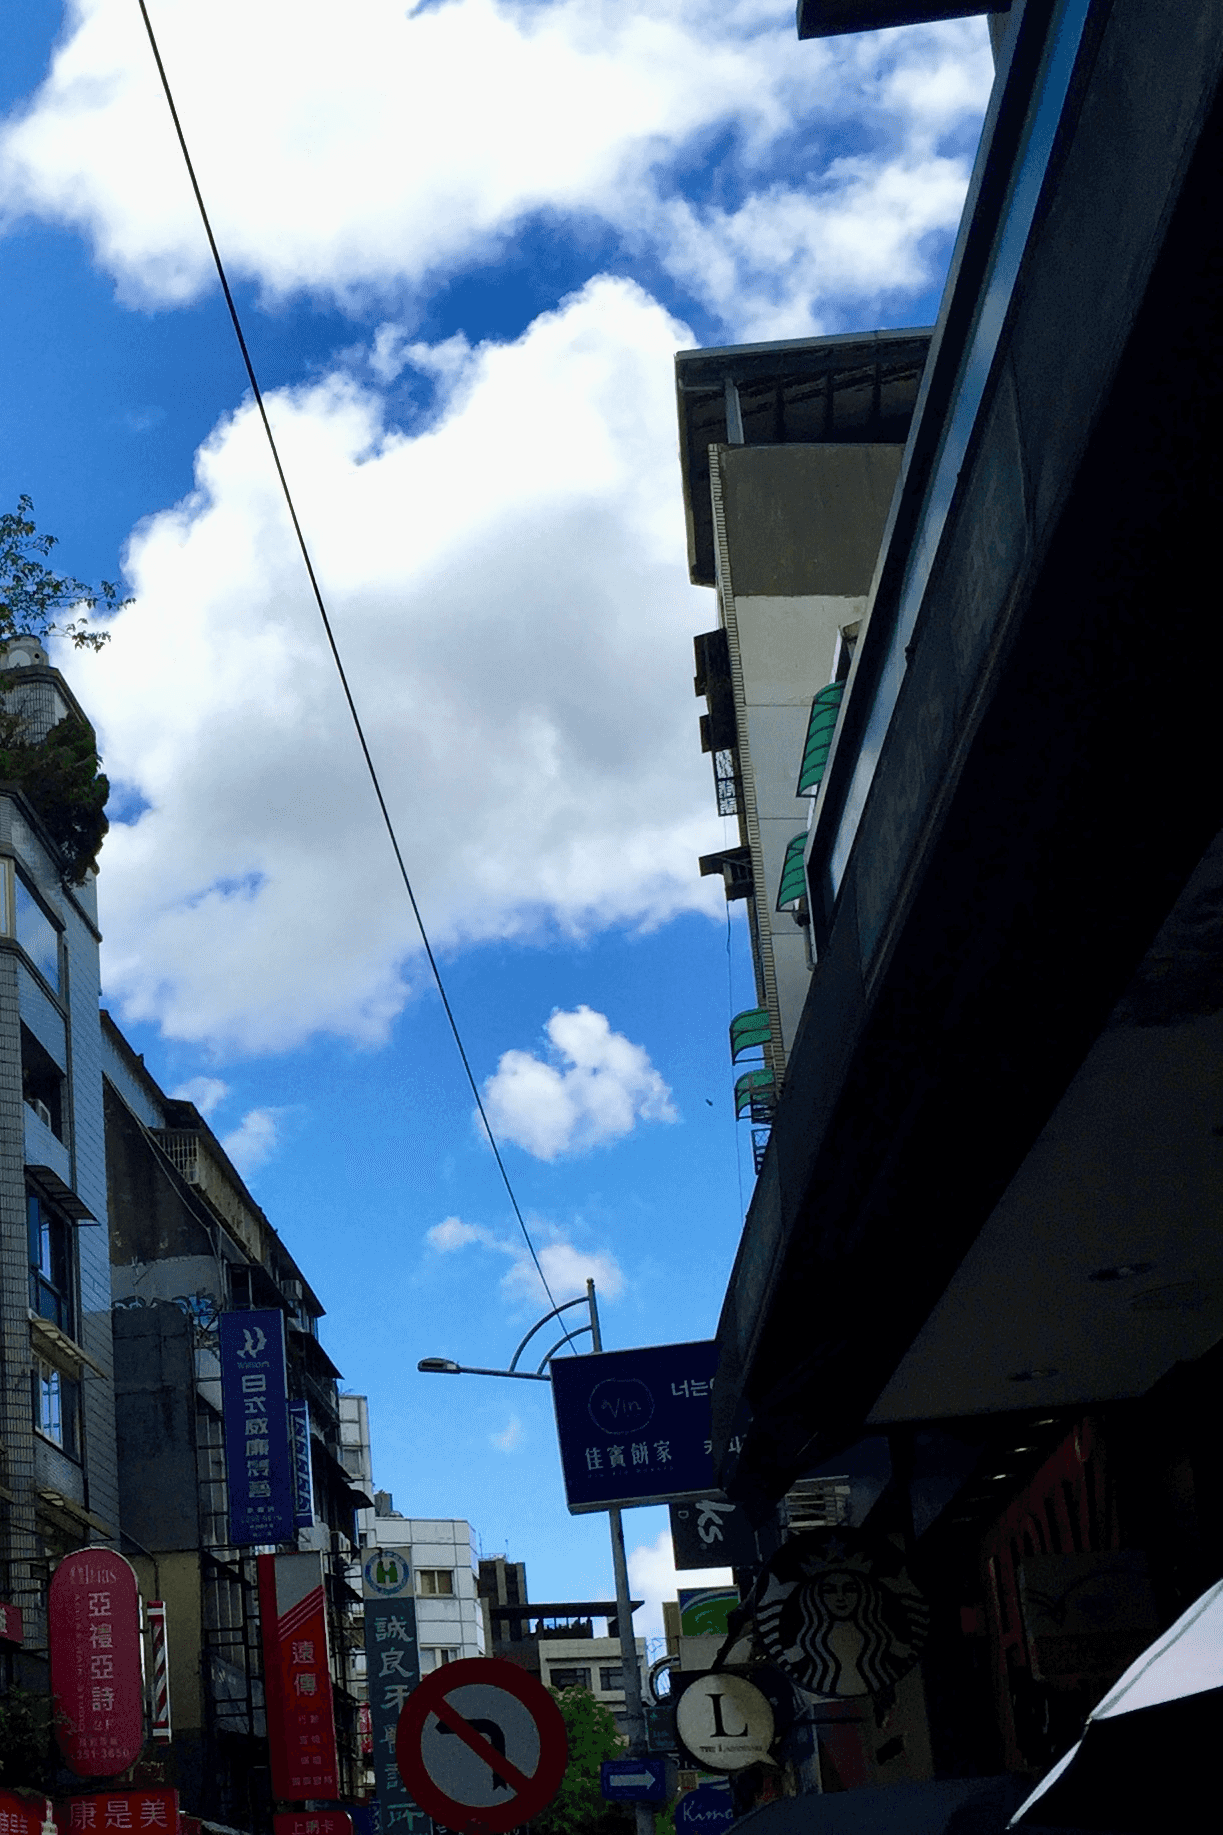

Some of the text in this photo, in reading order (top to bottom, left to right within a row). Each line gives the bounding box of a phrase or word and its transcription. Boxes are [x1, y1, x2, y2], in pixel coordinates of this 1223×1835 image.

[88, 1591, 115, 1711] 亞禮亞詩
[292, 1640, 317, 1697] 遠傳
[705, 1694, 749, 1737] L
[69, 1798, 169, 1831] 康是美
